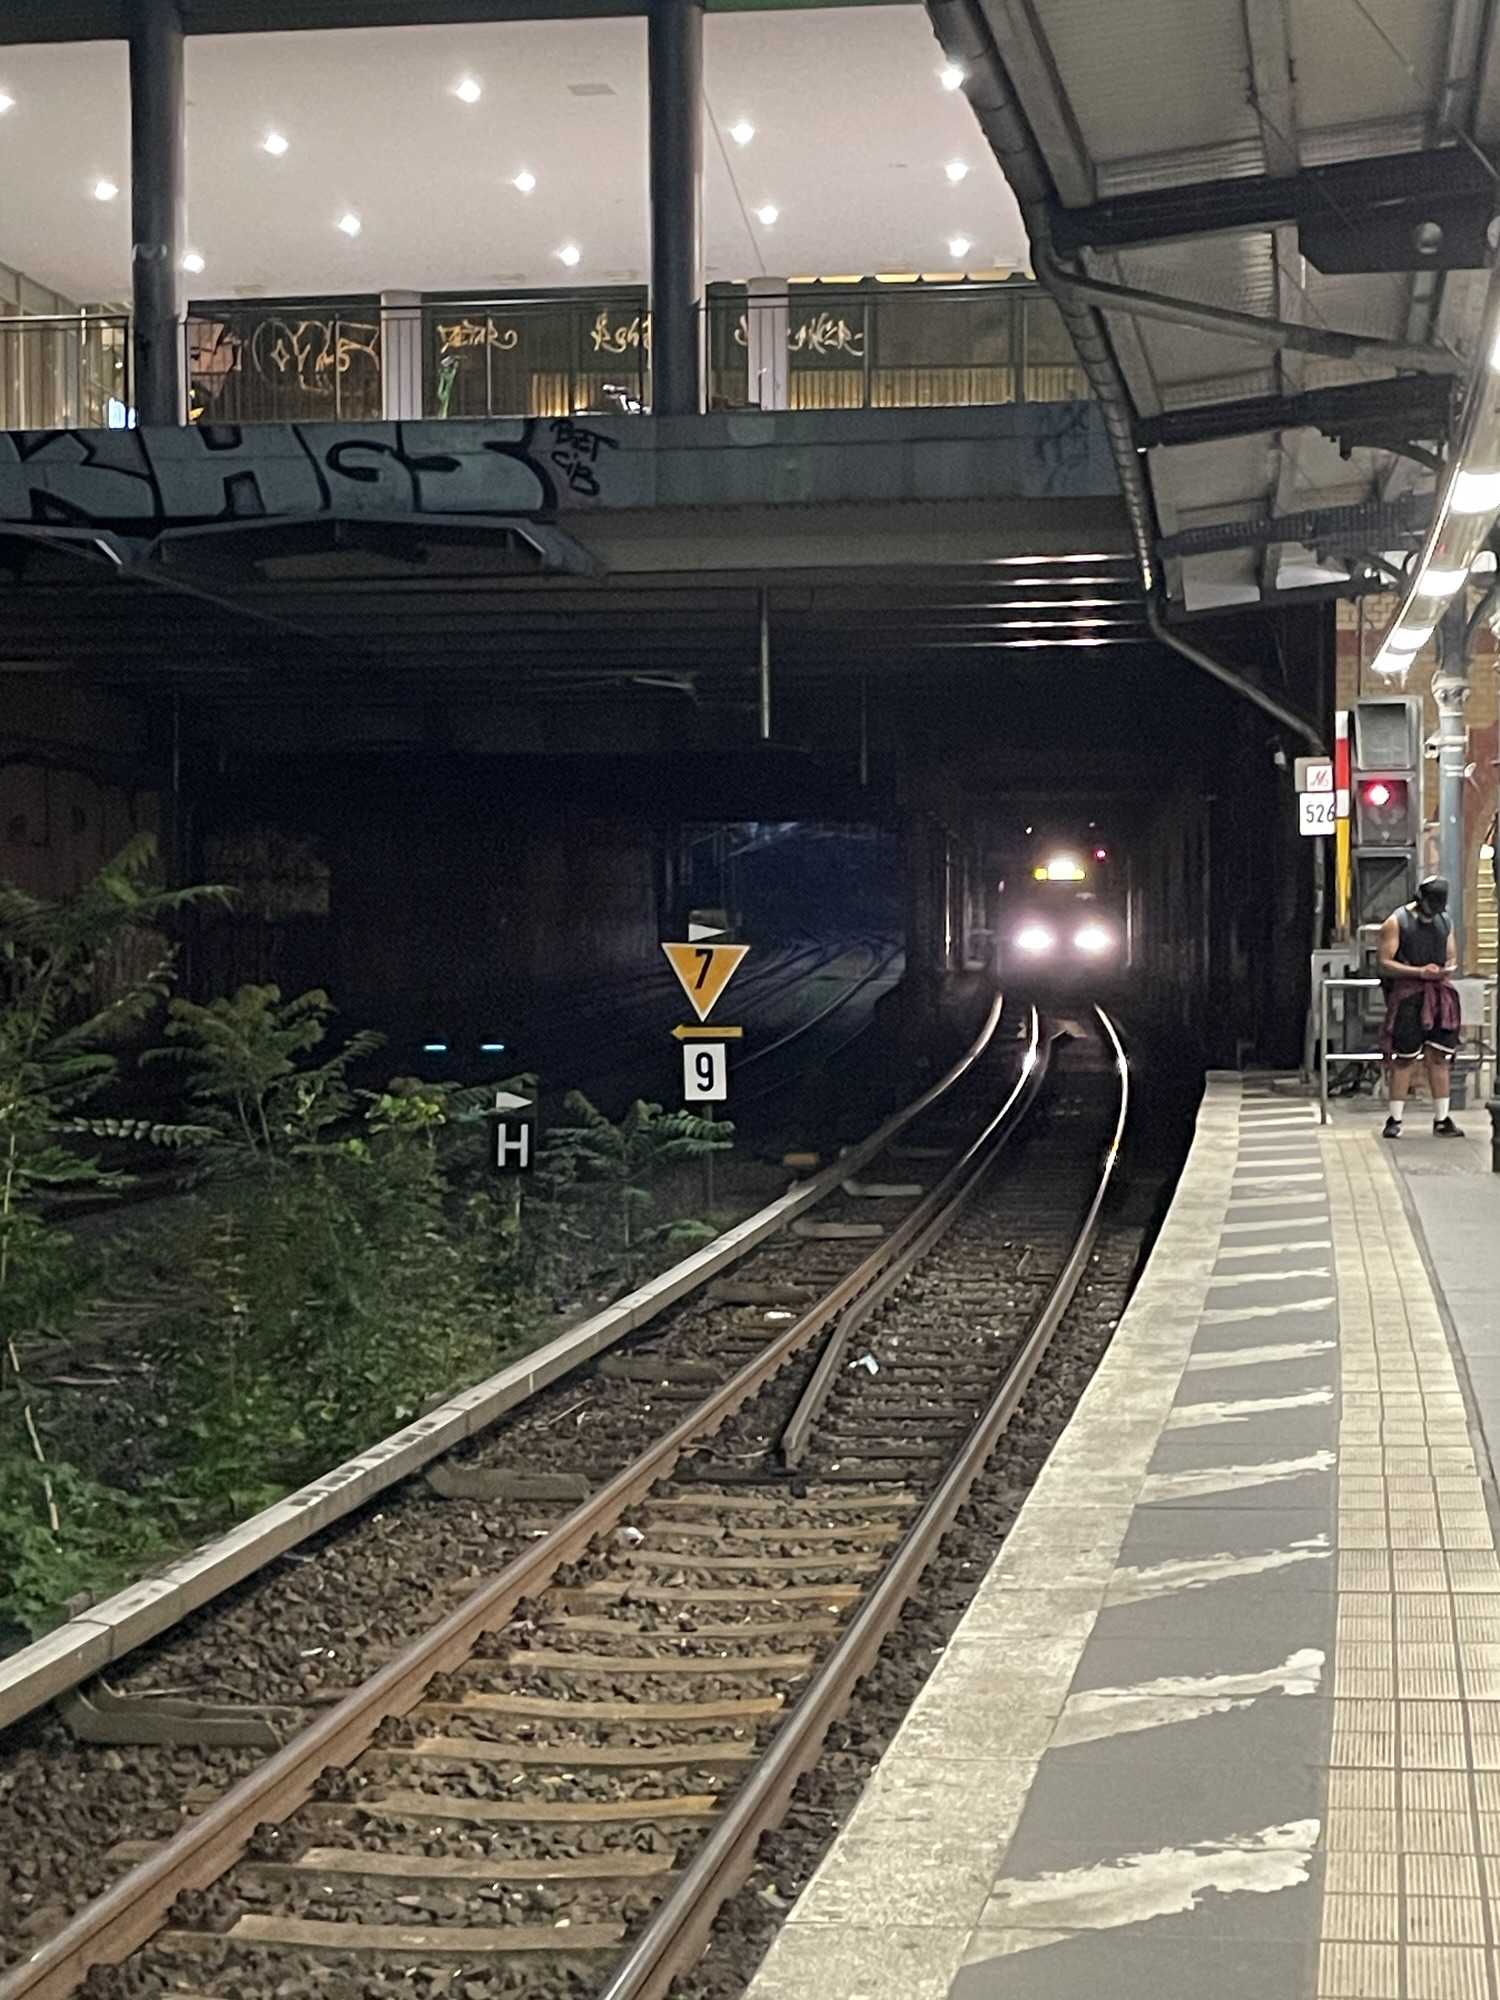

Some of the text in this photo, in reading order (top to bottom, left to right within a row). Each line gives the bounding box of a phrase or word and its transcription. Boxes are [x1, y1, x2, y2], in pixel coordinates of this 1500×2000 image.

[694, 948, 714, 990] 7
[694, 1051, 714, 1092] 9
[497, 1122, 529, 1168] H
